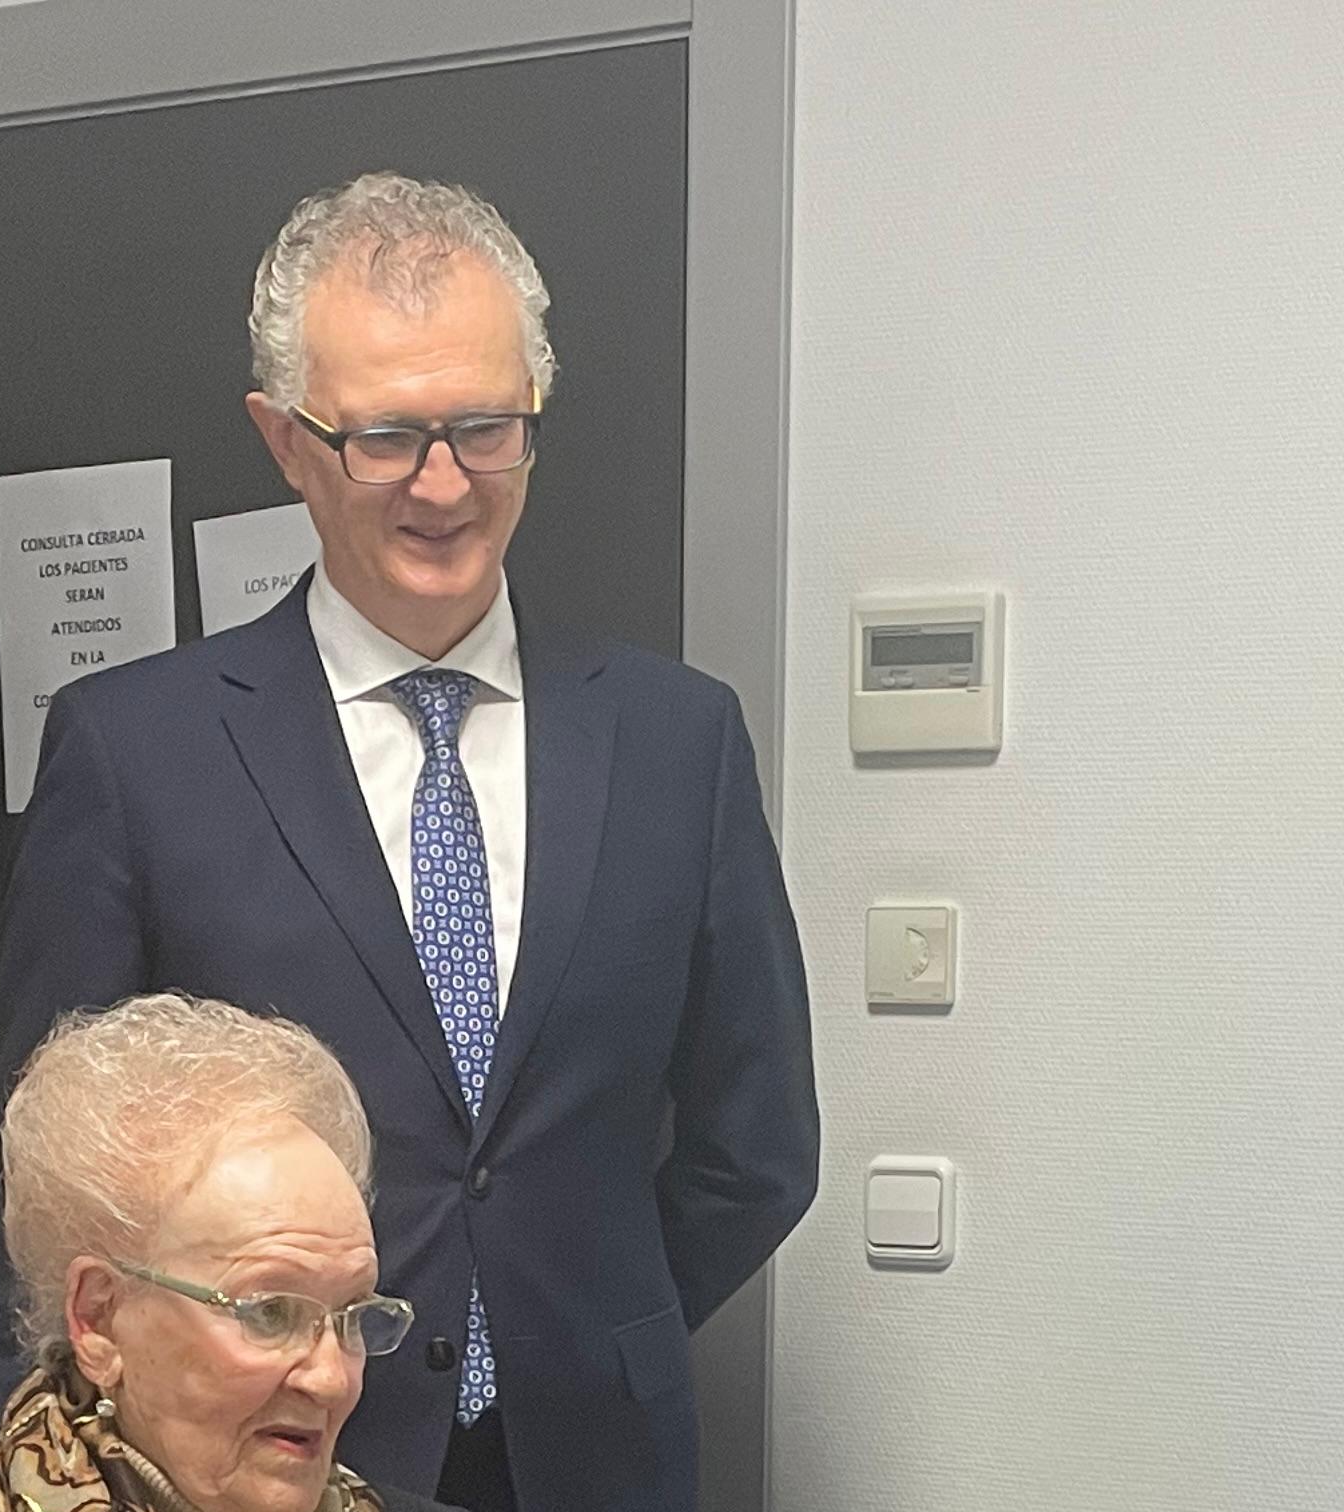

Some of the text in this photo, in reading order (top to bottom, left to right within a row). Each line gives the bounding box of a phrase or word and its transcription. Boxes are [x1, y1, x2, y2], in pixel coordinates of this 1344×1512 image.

[20, 527, 145, 552] CONSULTA CERRADA
[39, 557, 129, 578] LOS PACIENTES
[244, 578, 269, 594] LOS
[65, 587, 105, 603] SERAN
[51, 617, 122, 636] ATENDIDOS
[70, 651, 105, 666] EN LA
